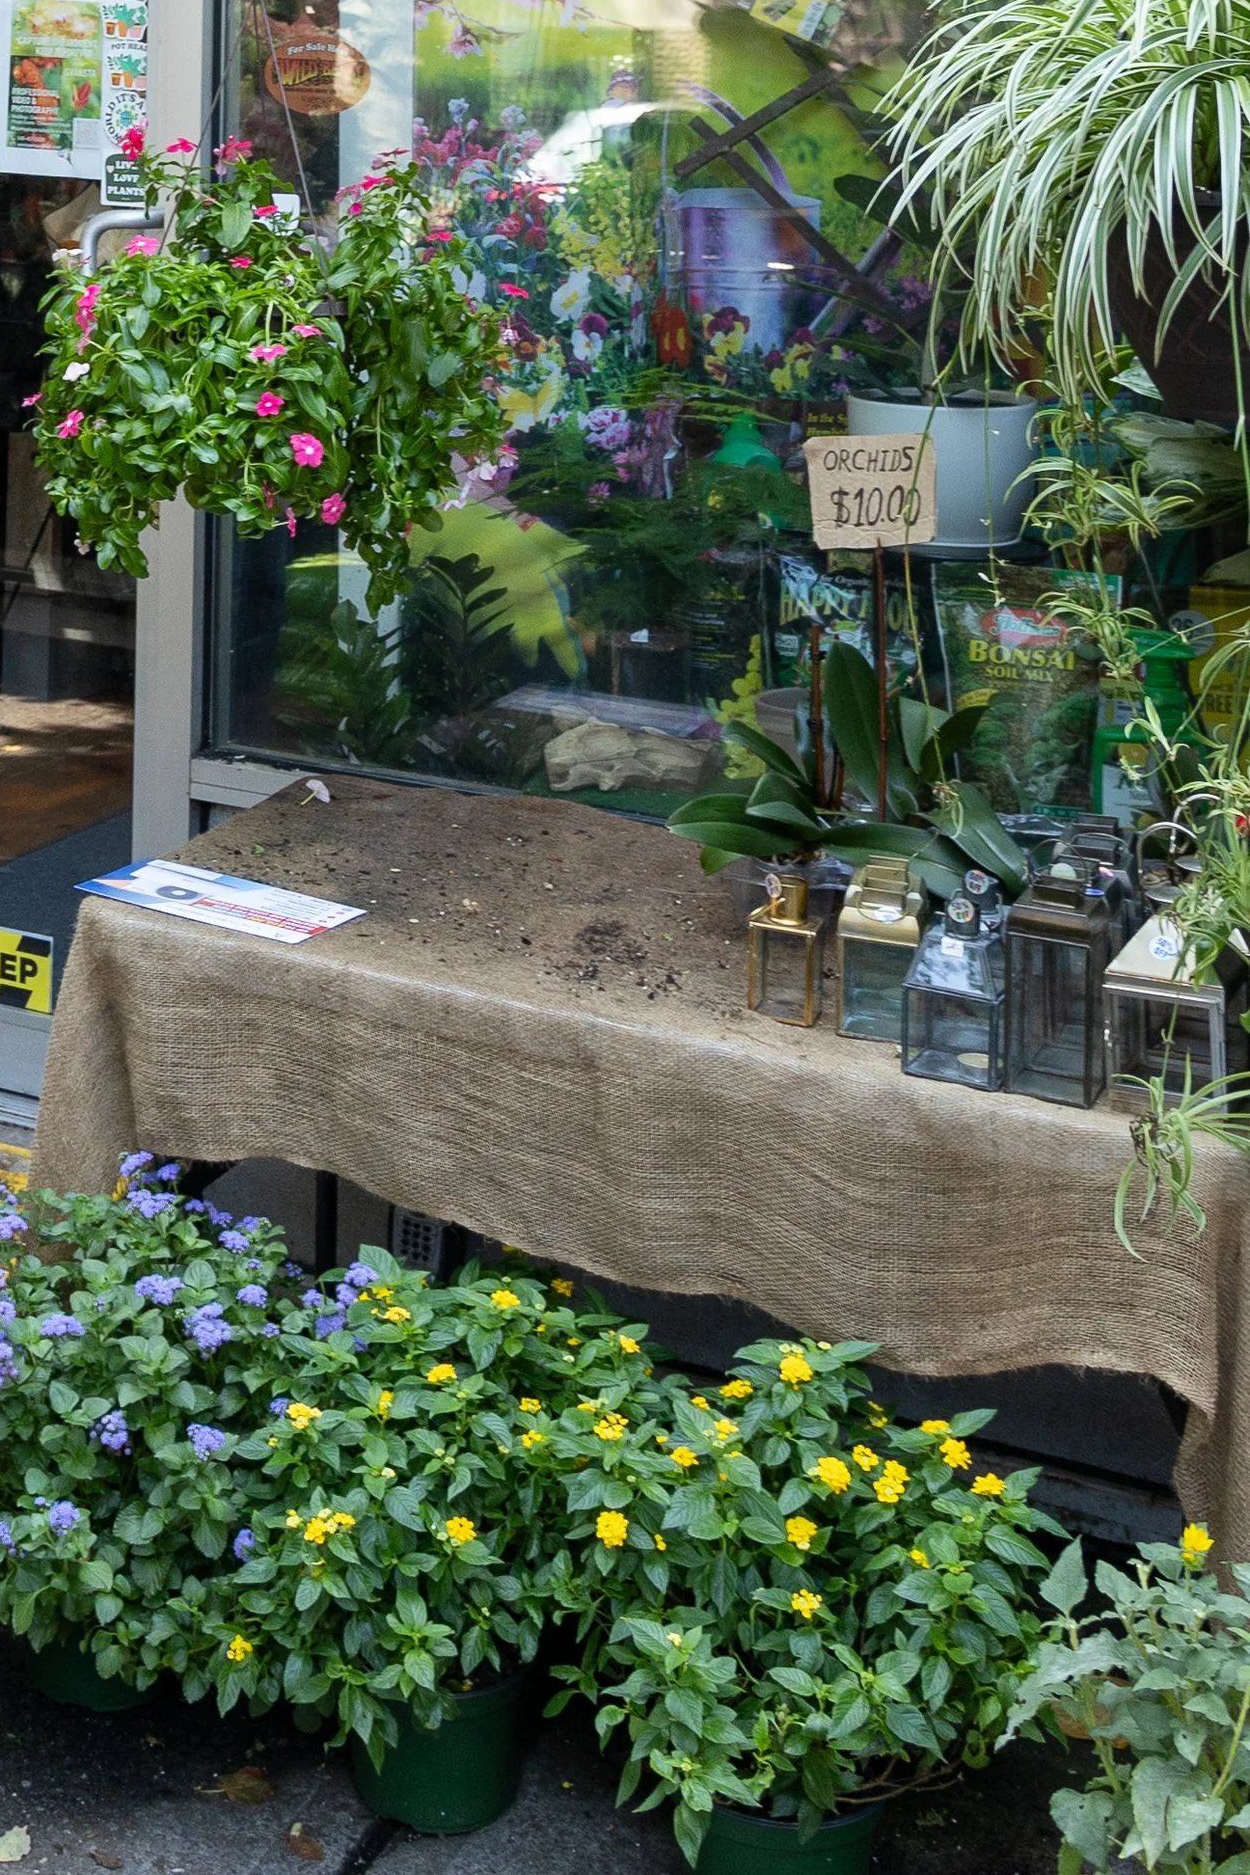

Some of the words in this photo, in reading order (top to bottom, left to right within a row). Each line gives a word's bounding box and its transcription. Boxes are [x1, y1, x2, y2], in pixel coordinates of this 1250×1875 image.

[115, 160, 139, 170] LIV
[107, 185, 146, 197] PLANTS
[823, 446, 915, 473] ORCHIDS
[830, 485, 921, 529] $10.00
[968, 639, 1076, 671] BONSAI
[986, 665, 1019, 680] SOIL
[1025, 668, 1054, 682] MIX
